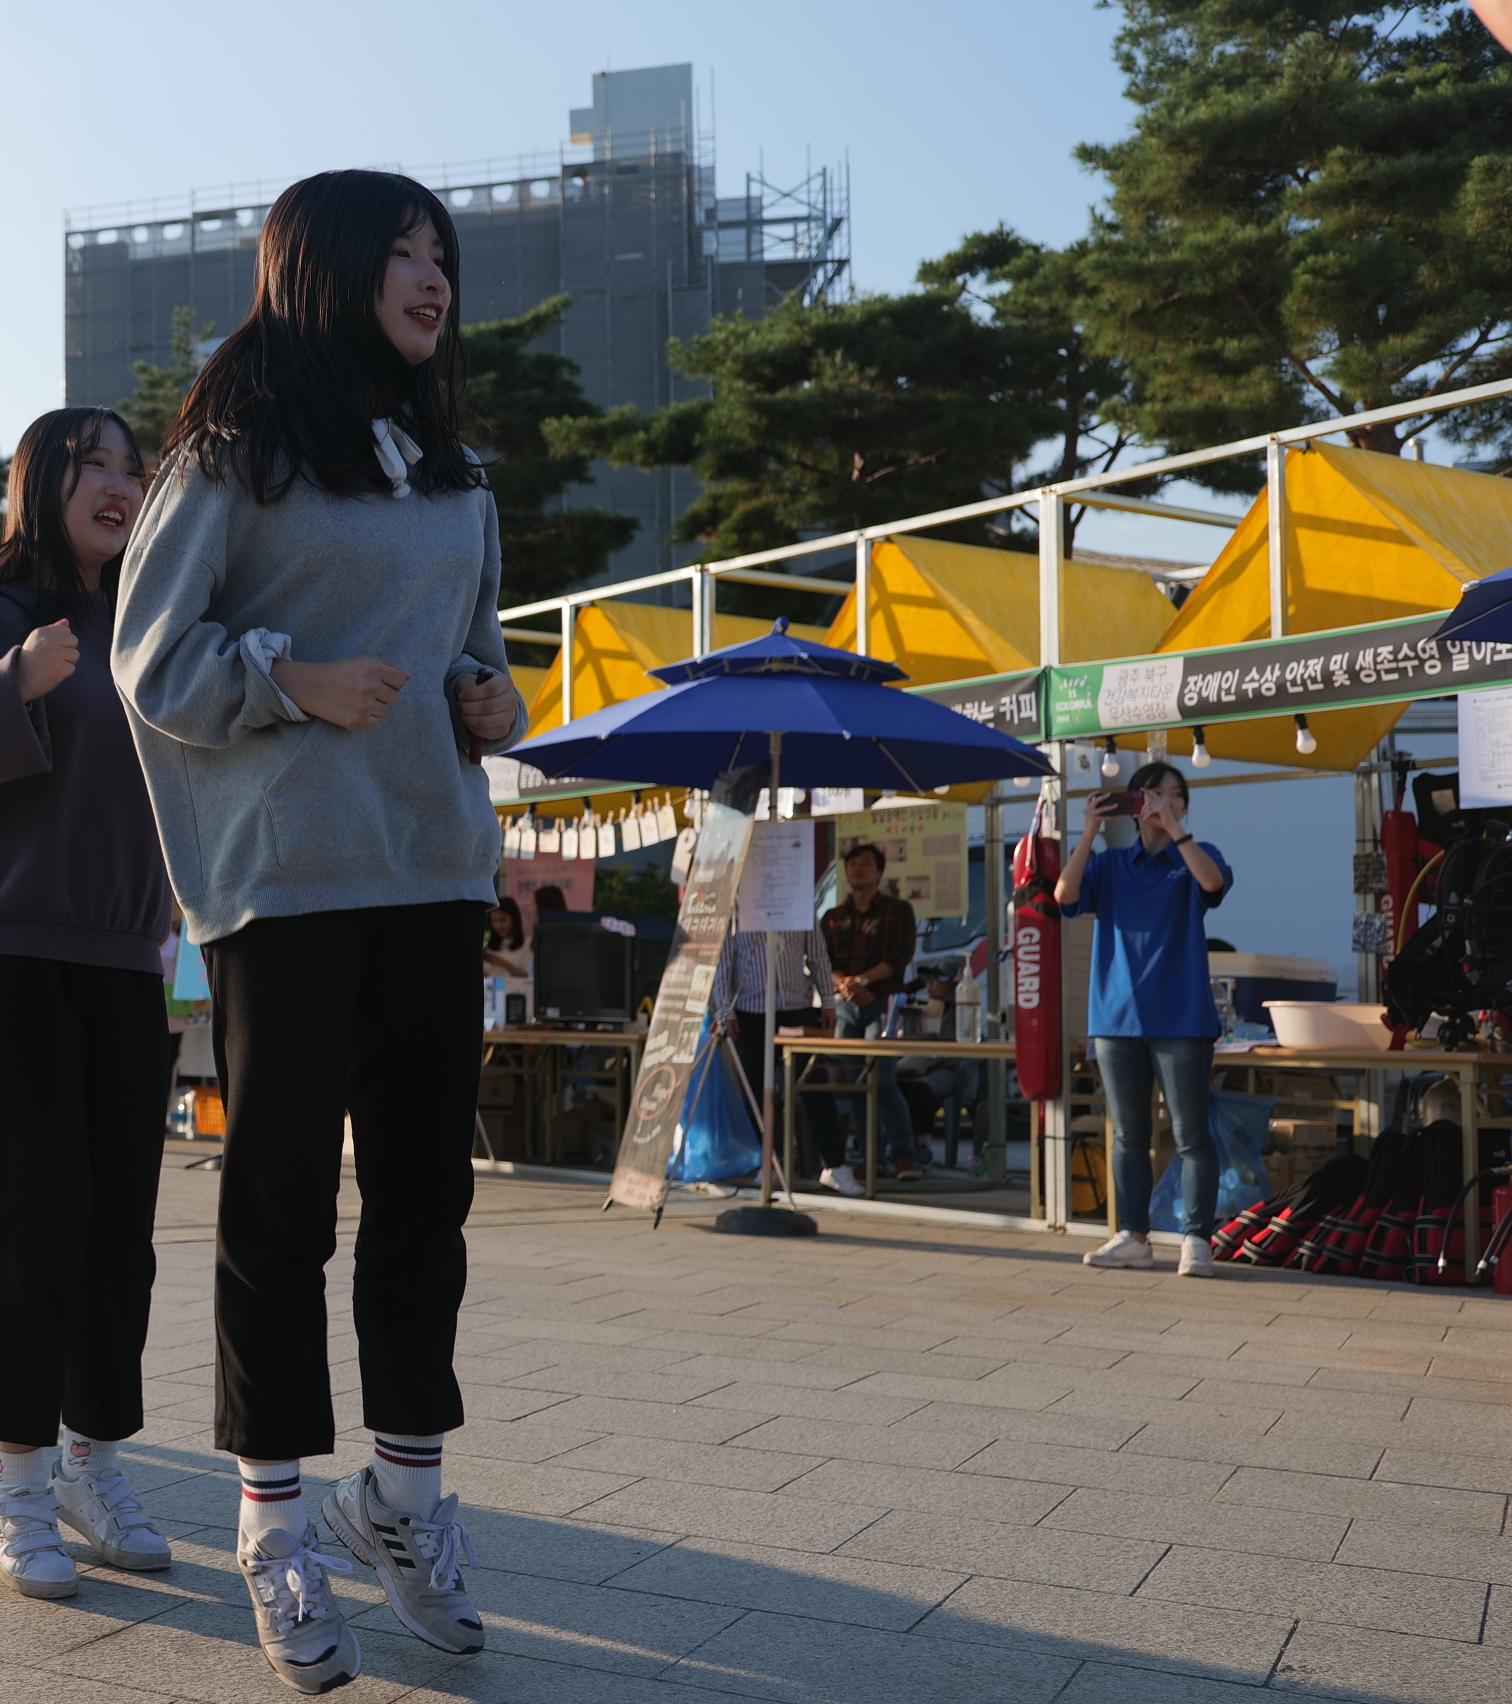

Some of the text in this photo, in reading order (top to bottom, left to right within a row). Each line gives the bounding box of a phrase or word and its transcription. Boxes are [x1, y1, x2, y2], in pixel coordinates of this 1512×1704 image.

[1183, 667, 1240, 707] 장애인
[1241, 661, 1281, 699] 수상
[1285, 656, 1325, 694] 안전
[1328, 651, 1352, 688] 및
[1354, 641, 1442, 685] 생존수영
[999, 691, 1038, 726] 커피
[1017, 926, 1042, 1010] GUARD
